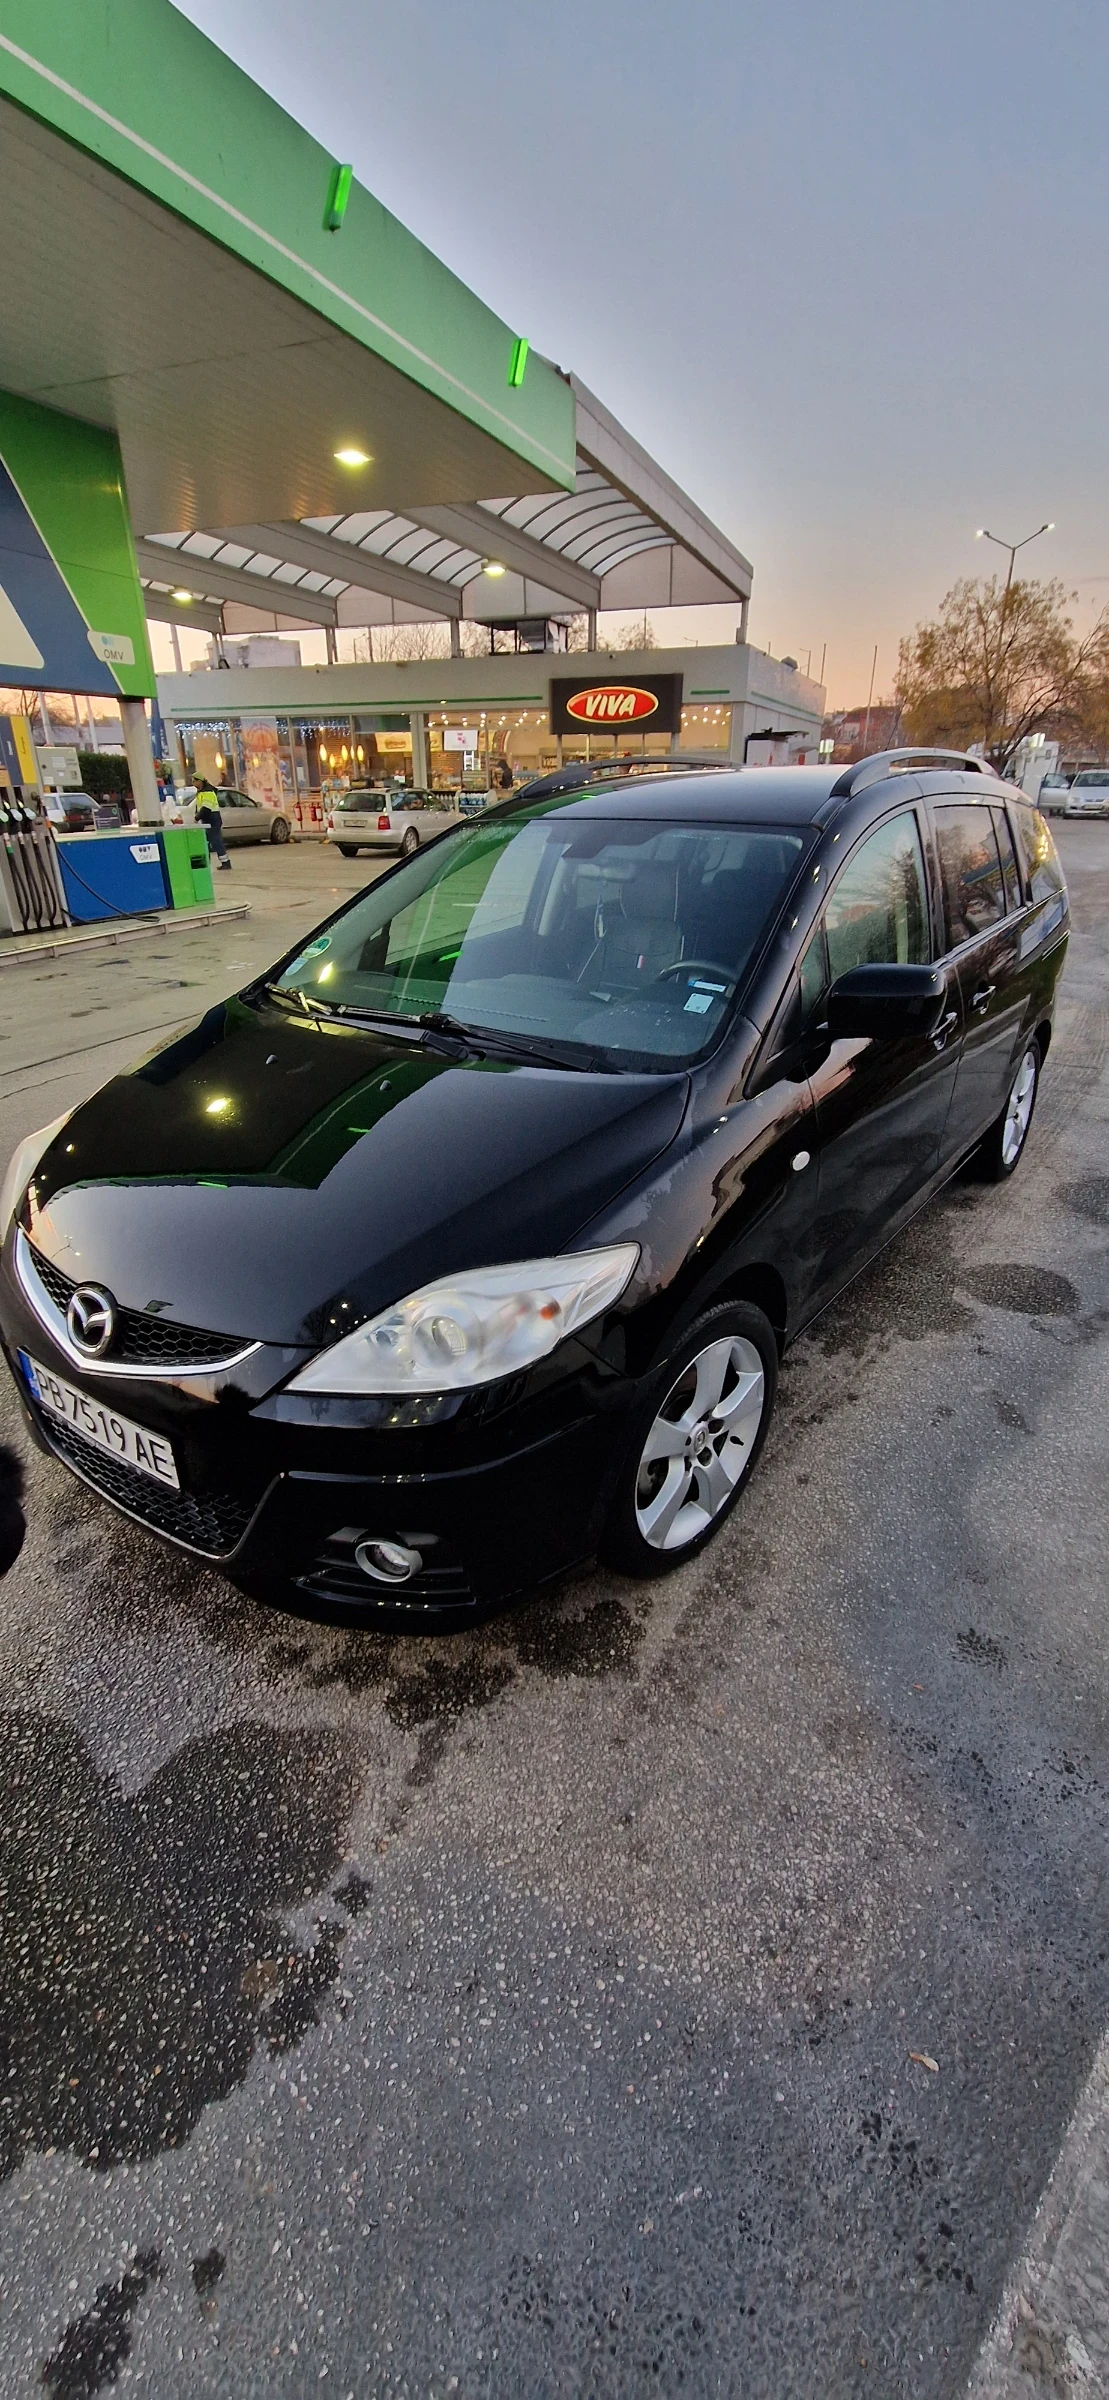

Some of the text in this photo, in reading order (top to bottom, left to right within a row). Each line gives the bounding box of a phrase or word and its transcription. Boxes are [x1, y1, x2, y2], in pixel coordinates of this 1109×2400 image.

[103, 648, 124, 660] OMV
[585, 693, 637, 717] VIVA
[34, 1366, 173, 1479] PB 7519 AE
